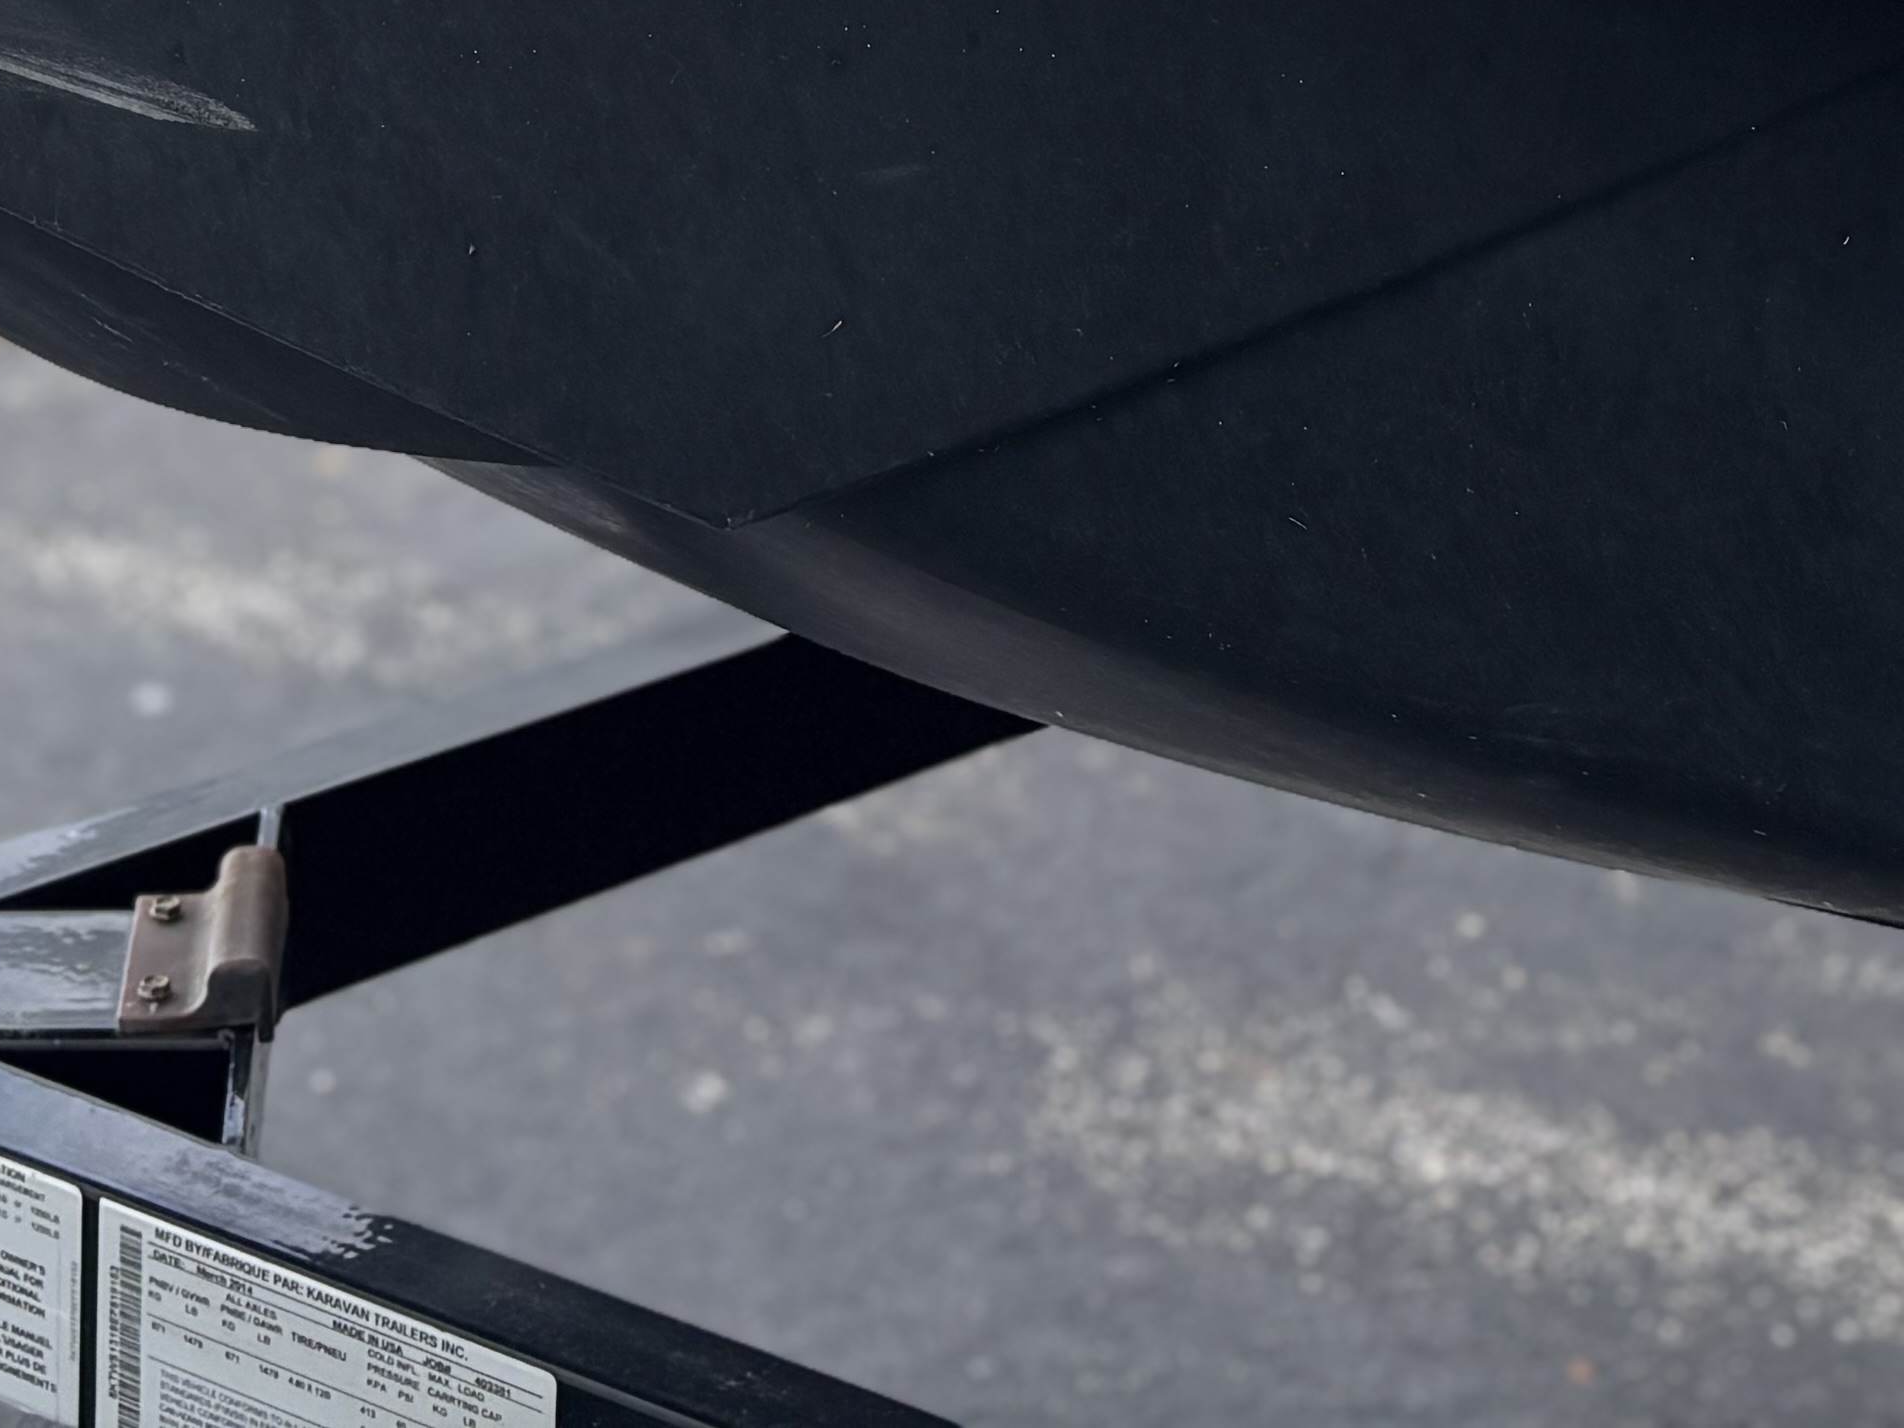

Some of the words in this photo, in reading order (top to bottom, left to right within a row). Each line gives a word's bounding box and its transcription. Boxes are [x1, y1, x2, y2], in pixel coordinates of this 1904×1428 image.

[153, 1248, 184, 1270] DATE:
[23, 1272, 43, 1290] FOR
[154, 1225, 181, 1249] MFD
[184, 1237, 270, 1284] BY/FABRIQUE
[273, 1272, 303, 1297] PAR:
[306, 1285, 370, 1323] KARAVAN
[374, 1312, 437, 1350] TRAILERS
[441, 1339, 468, 1362] INC.
[332, 1319, 366, 1343] MADE
